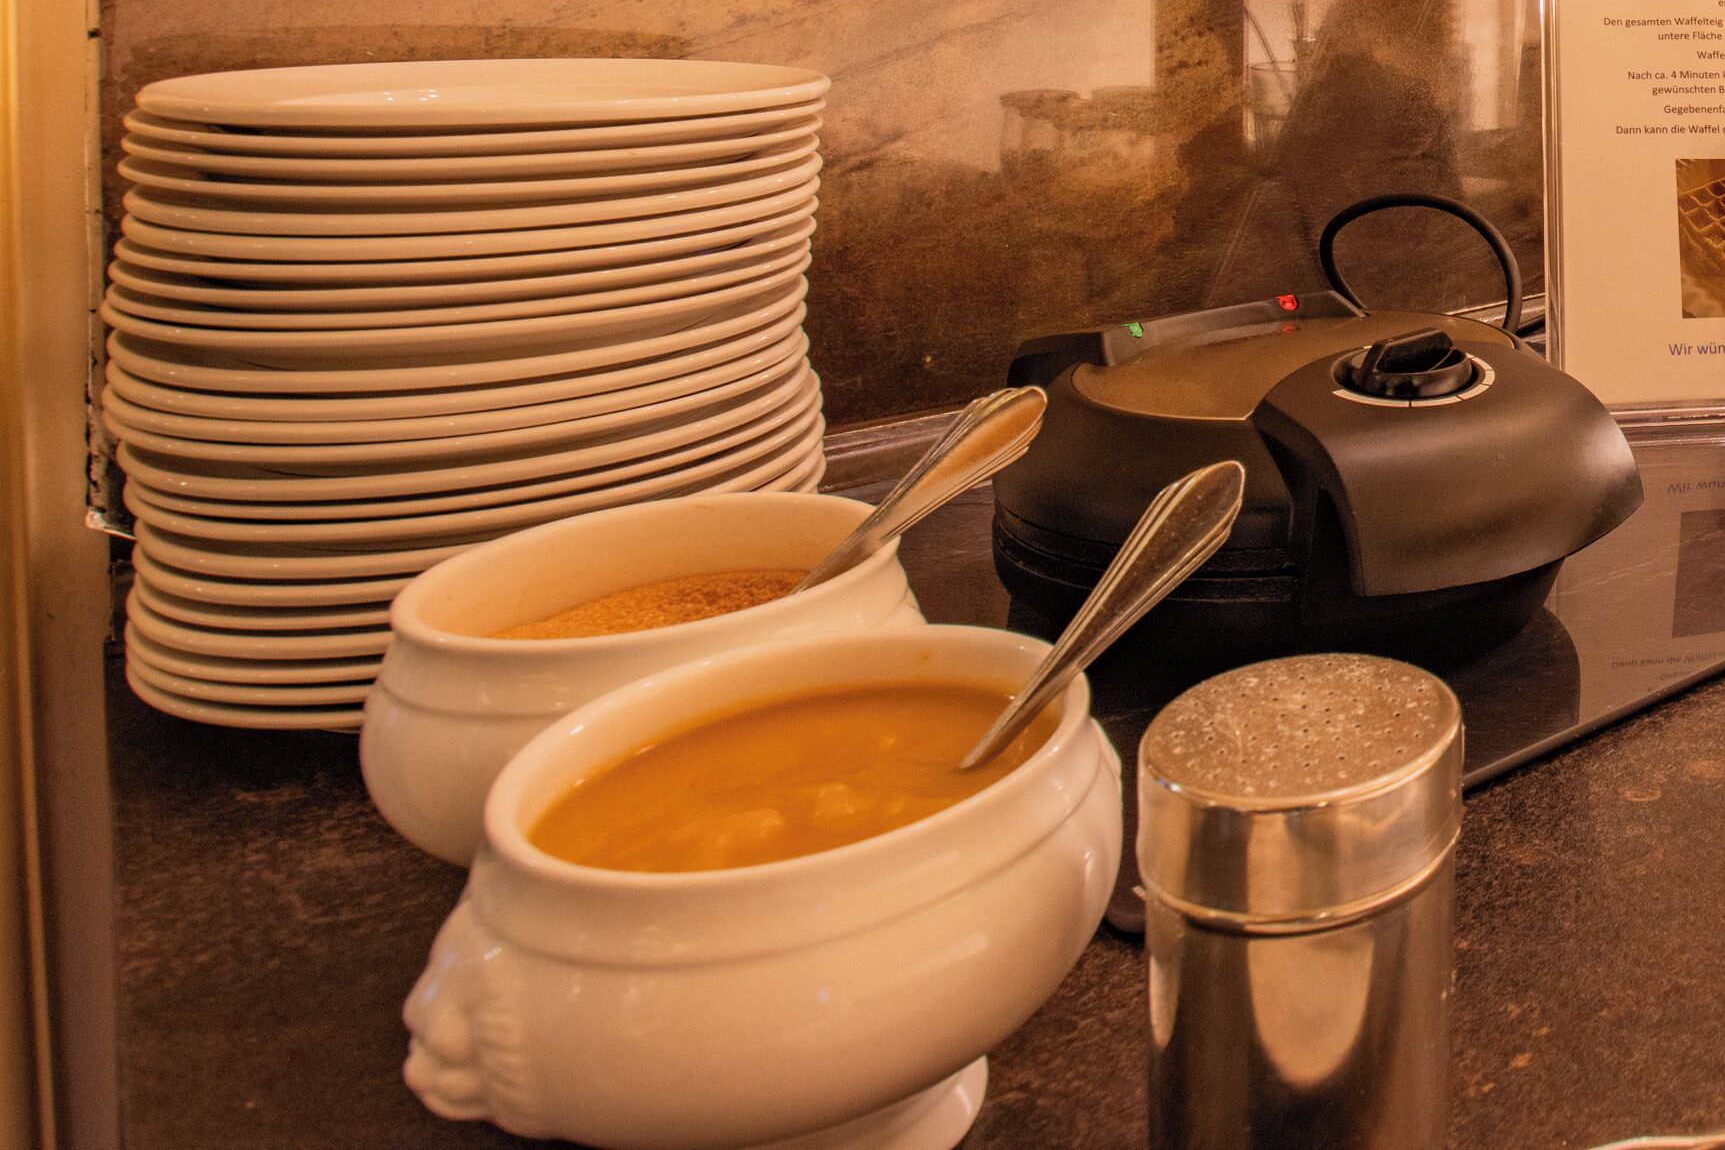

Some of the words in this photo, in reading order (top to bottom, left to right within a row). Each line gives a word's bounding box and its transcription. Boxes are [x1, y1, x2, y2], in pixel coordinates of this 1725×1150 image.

[1603, 17, 1623, 26] Den
[1625, 18, 1672, 28] gesamten
[1674, 17, 1723, 28] Waffelteig
[1658, 32, 1689, 41] untere
[1692, 31, 1722, 41] Fläche
[1627, 71, 1652, 80] Nach
[1654, 72, 1668, 80] ca.
[1670, 70, 1677, 79] 4
[1680, 70, 1720, 80] Minuten
[1652, 84, 1716, 96] gewünschten
[1616, 125, 1641, 135] Dann
[1644, 125, 1668, 135] kann
[1670, 124, 1686, 134] die
[1688, 124, 1720, 135] Waffel
[1669, 343, 1693, 356] Wir
